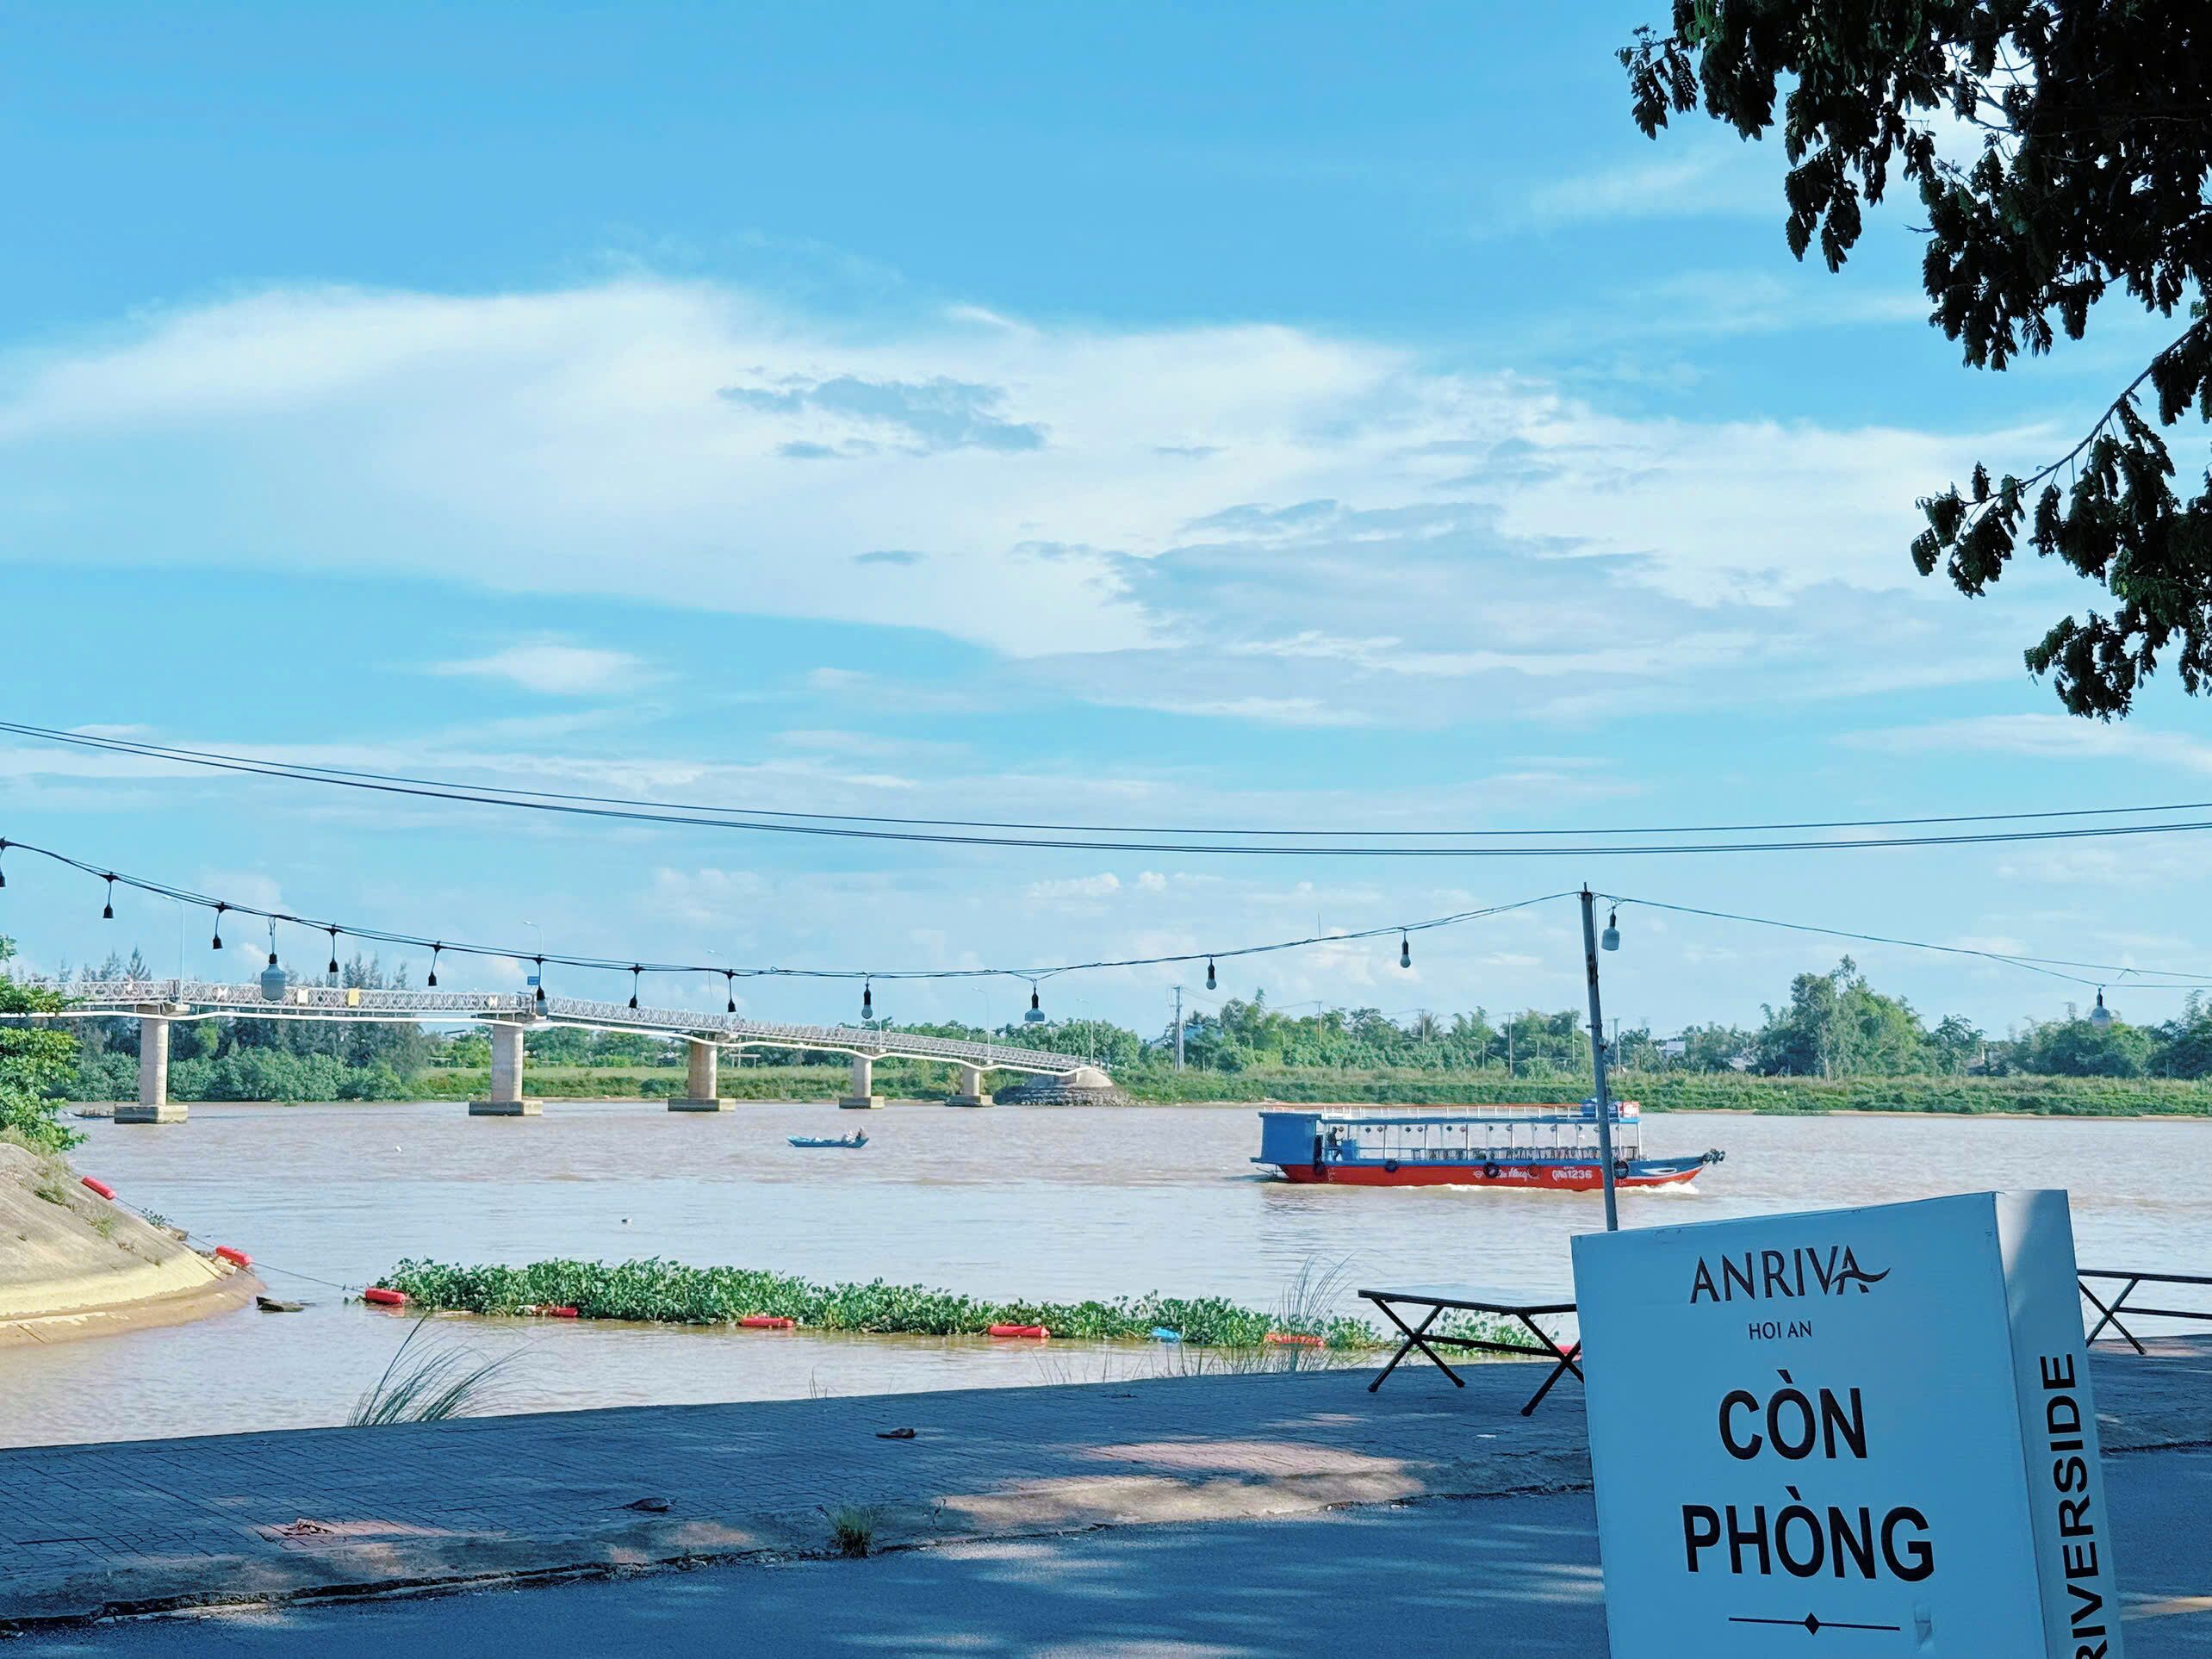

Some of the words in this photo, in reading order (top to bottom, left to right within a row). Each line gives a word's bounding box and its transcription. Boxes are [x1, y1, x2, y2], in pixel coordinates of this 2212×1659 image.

[1690, 1245, 1891, 1304] ANRIVA
[1749, 1321, 1782, 1340] HOI
[1787, 1320, 1812, 1339] AN
[1718, 1369, 1868, 1461] CÒN
[1681, 1484, 1936, 1582] PHÒNG
